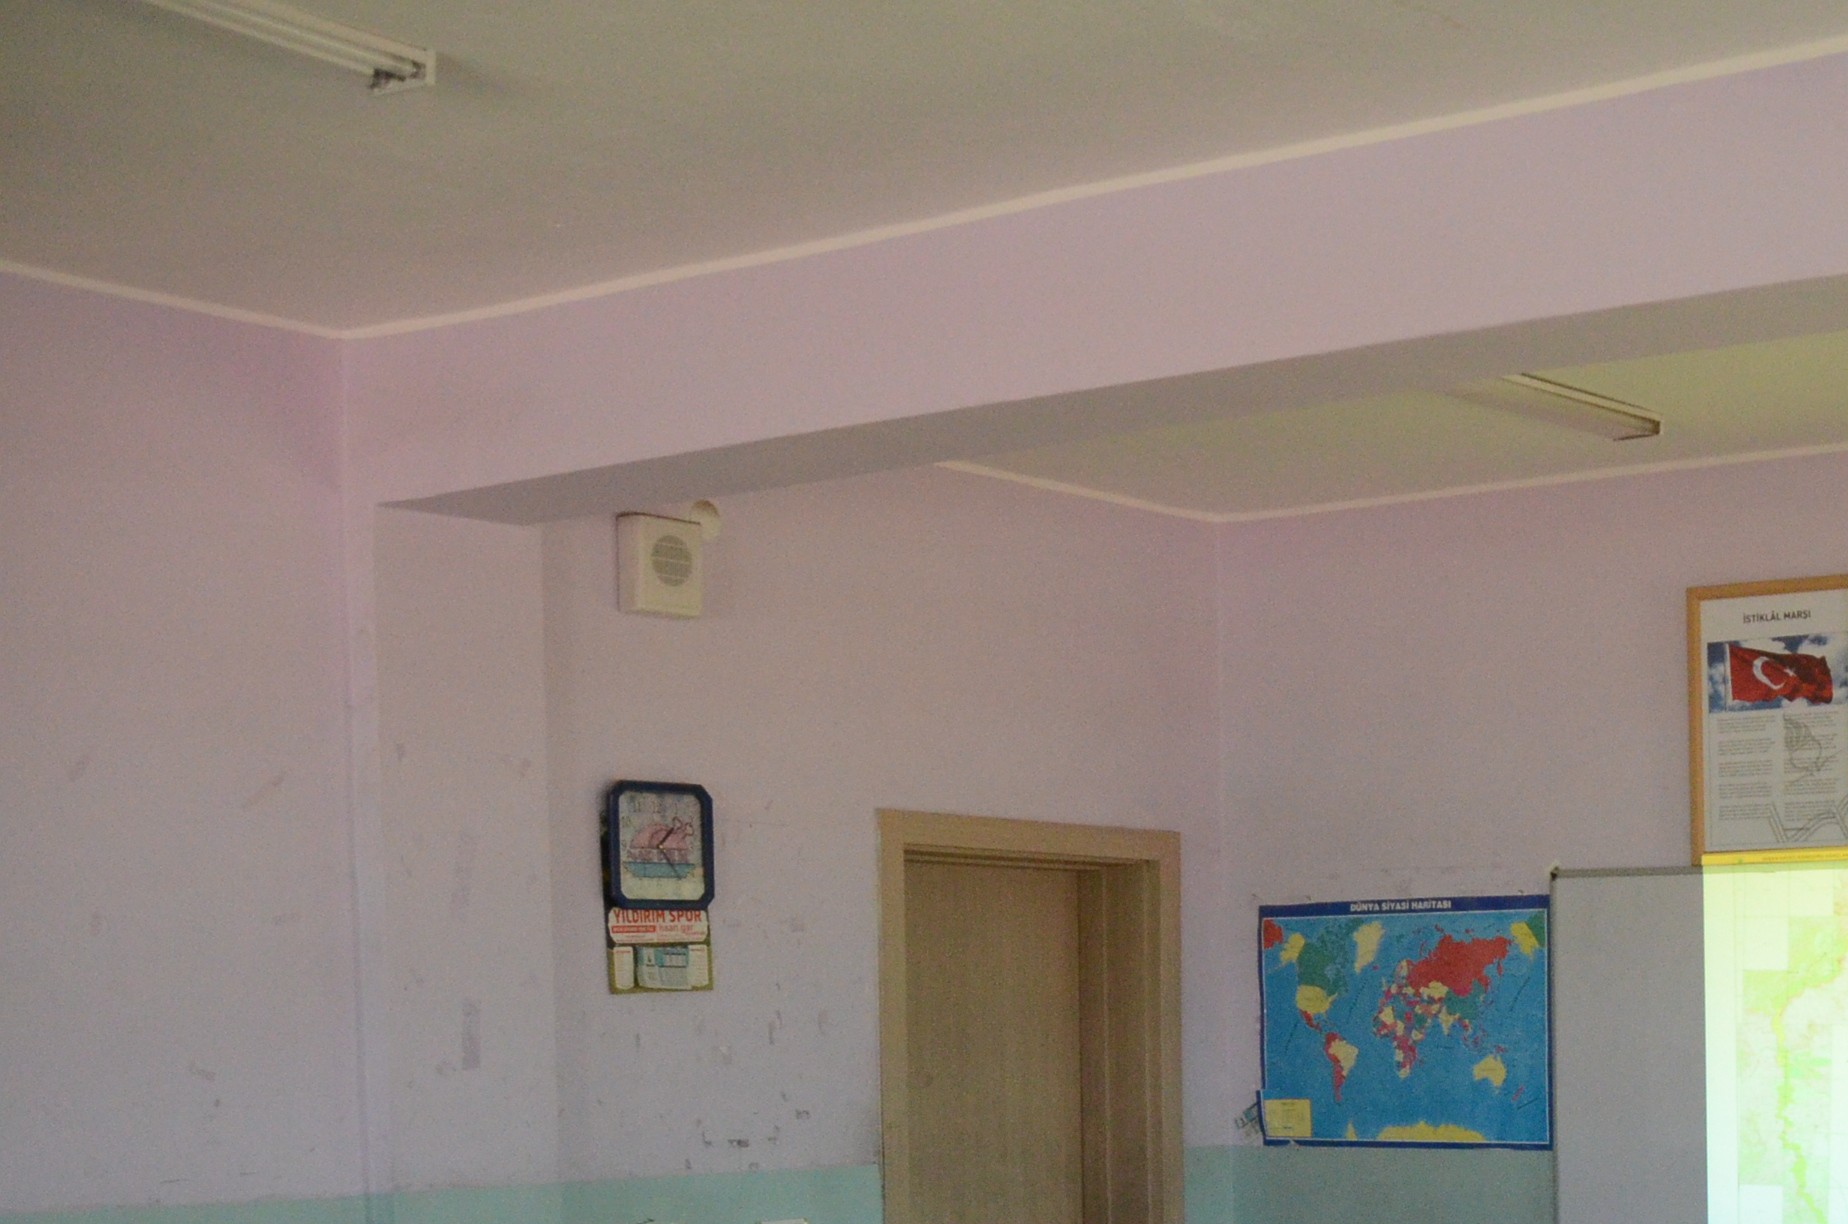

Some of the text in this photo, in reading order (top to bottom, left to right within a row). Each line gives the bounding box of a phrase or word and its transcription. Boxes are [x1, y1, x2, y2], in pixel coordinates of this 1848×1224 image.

[1350, 898, 1452, 912] DÜNYA SİYASİ HARİTASI
[669, 908, 702, 922] SPOR
